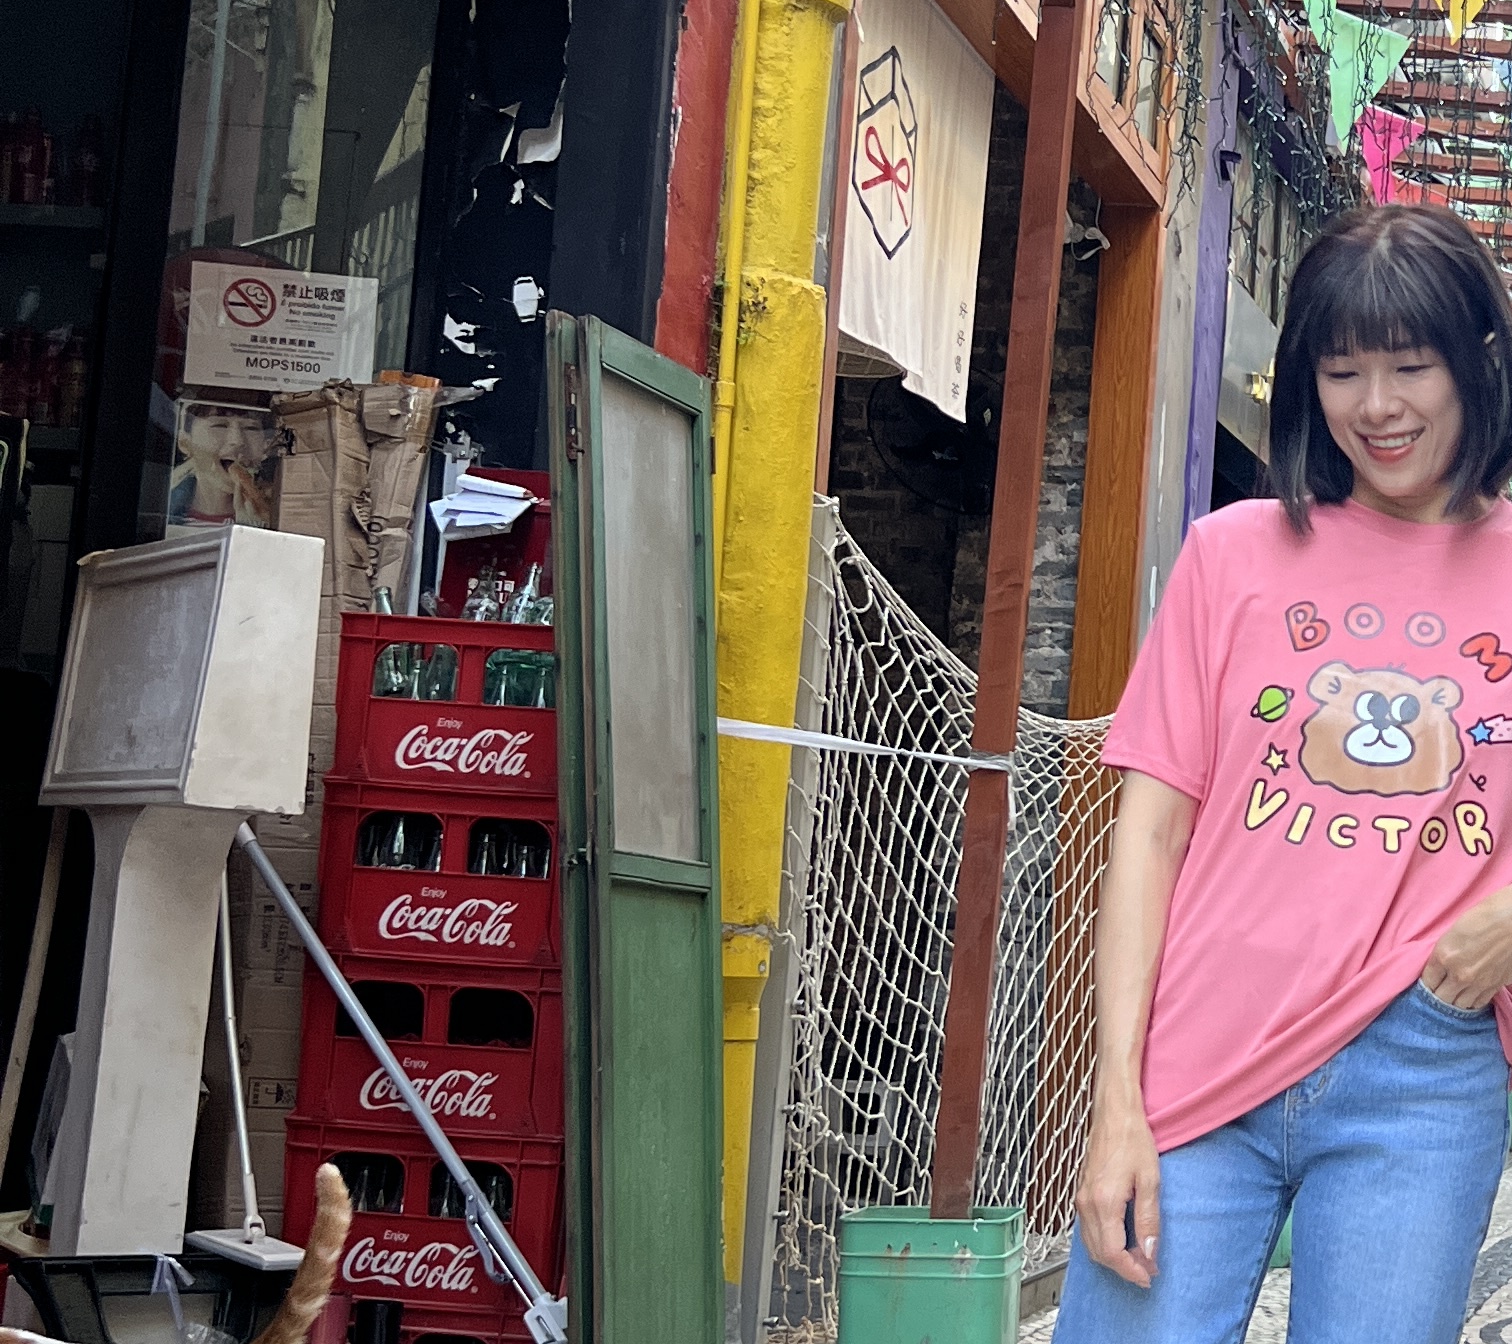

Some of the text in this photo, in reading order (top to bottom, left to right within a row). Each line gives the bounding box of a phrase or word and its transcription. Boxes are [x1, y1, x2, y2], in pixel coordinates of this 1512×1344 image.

[282, 283, 345, 303] 禁止吸煙
[437, 717, 463, 730] Enjoy
[395, 724, 534, 776] Coca-Cola
[1244, 778, 1494, 856] VICTOR
[421, 886, 447, 899] Enjoy
[378, 893, 519, 947] Coca-Cola
[402, 1057, 429, 1070] Enjoy
[383, 1229, 409, 1243] Enjoy
[342, 1237, 479, 1291] Coca-Cola
